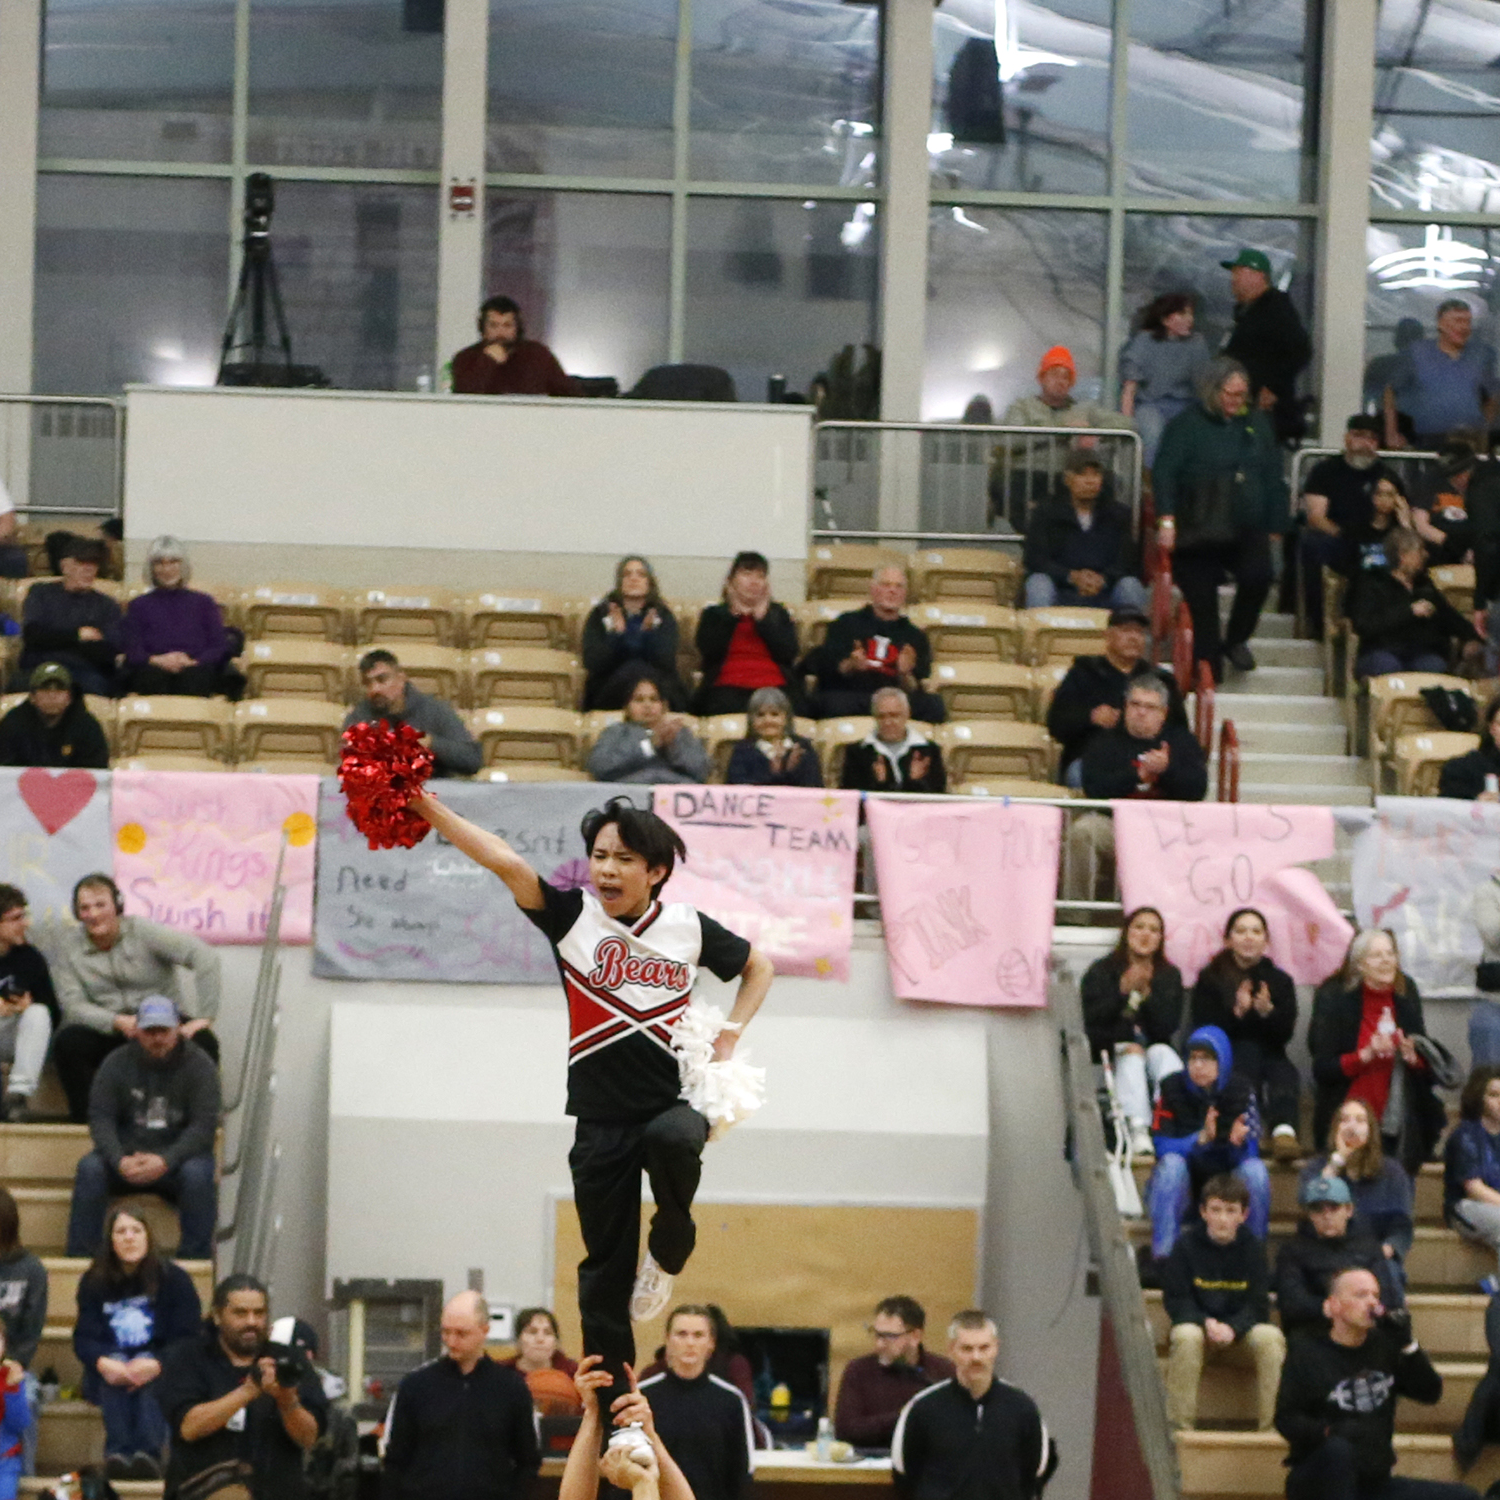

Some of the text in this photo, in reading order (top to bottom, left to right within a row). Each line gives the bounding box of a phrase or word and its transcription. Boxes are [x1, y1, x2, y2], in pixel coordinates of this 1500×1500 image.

[673, 790, 776, 820] DANCE
[765, 822, 855, 850] TEAM
[589, 935, 689, 991] Bears
